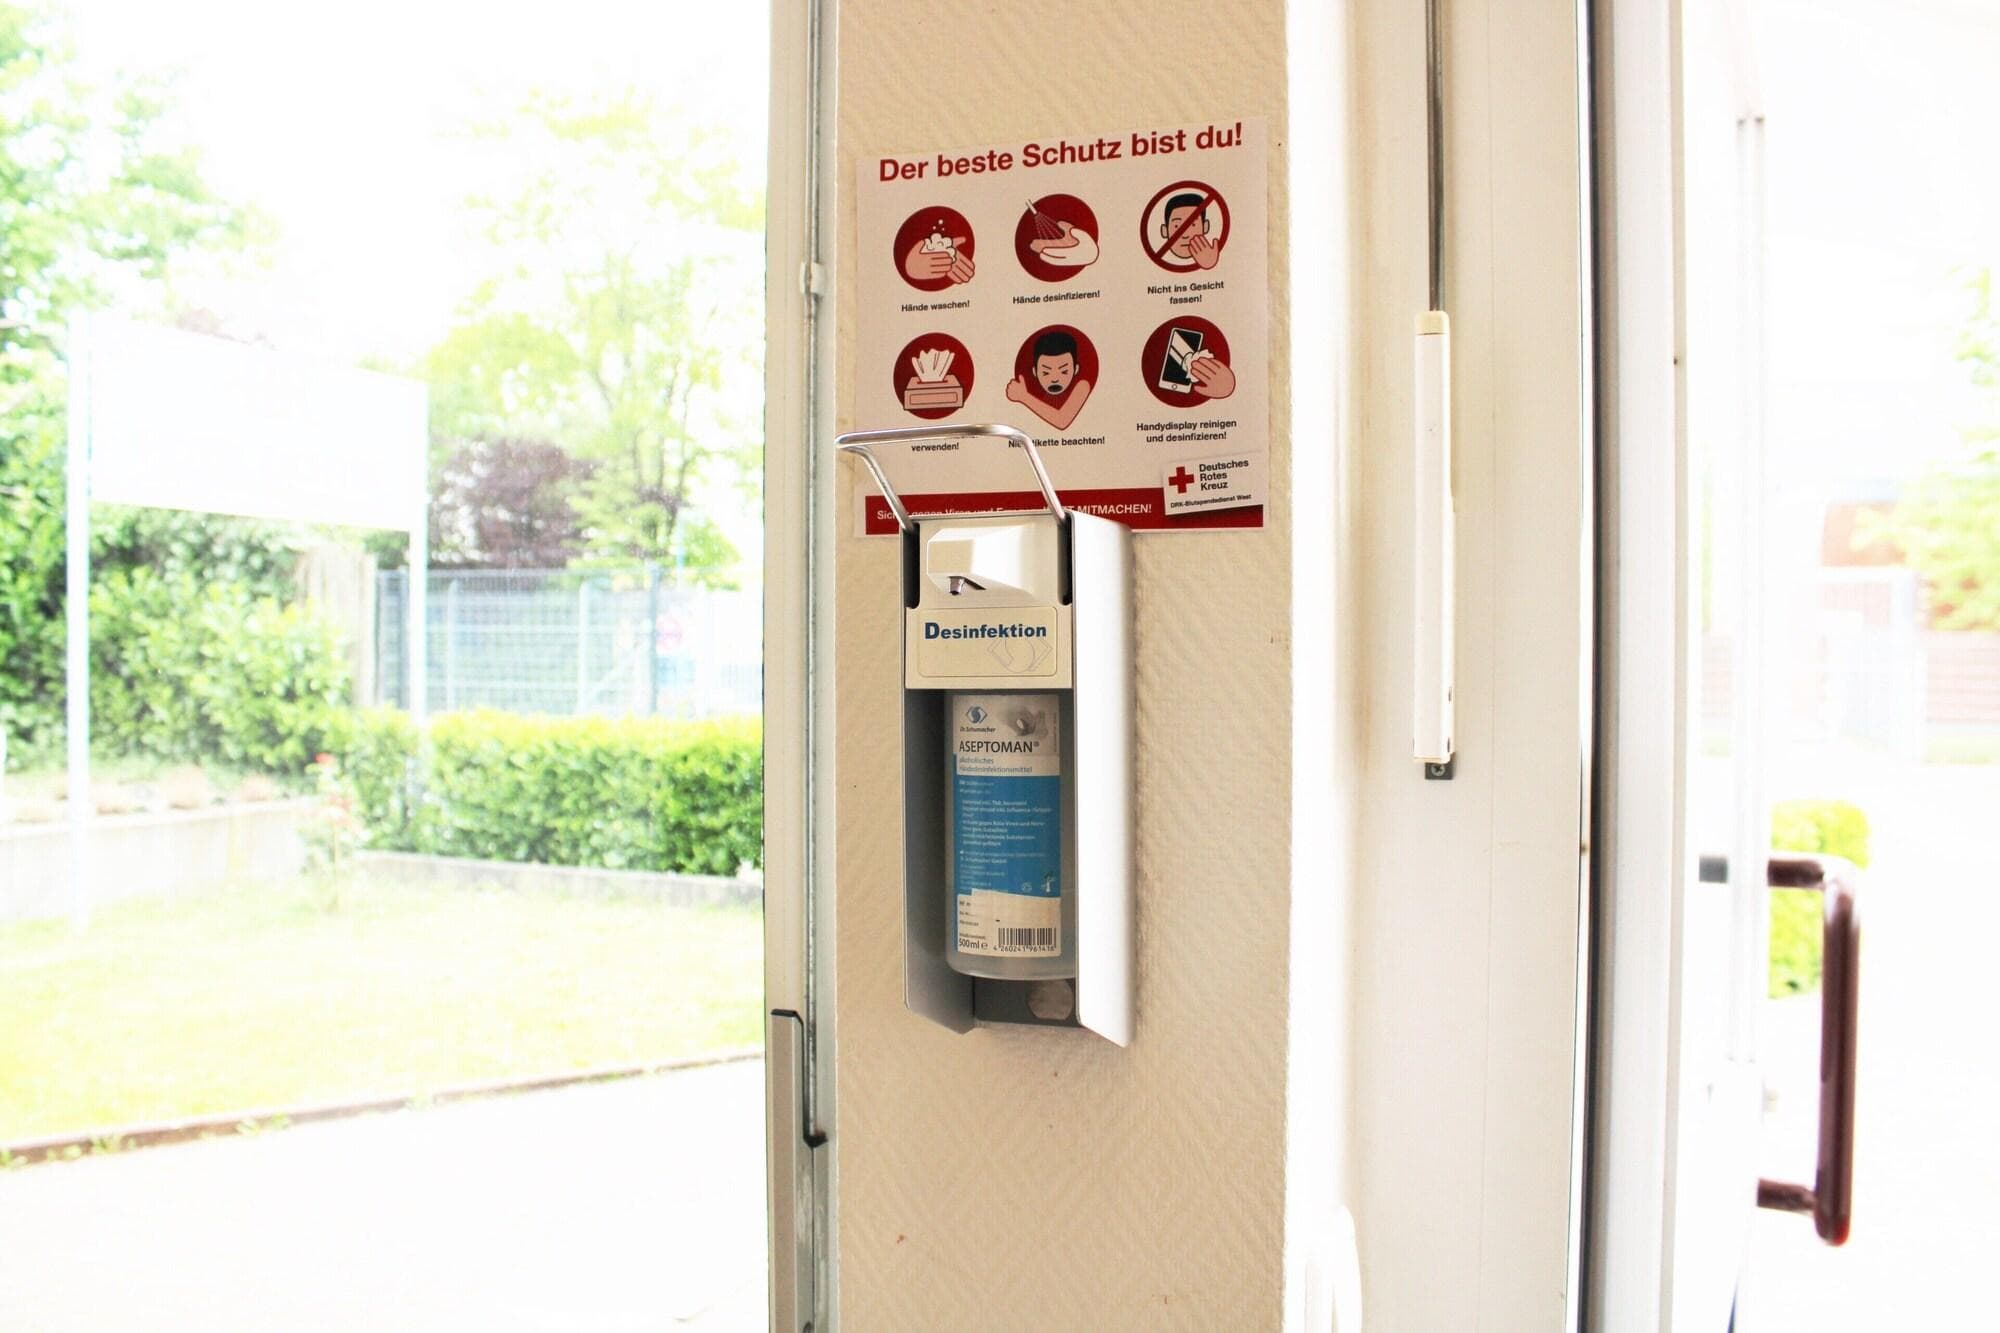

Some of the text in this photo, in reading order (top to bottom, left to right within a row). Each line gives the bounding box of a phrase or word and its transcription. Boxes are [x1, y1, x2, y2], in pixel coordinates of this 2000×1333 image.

[880, 122, 1242, 182] Der beste Schutz bist du!
[1147, 281, 1224, 294] Nicht ins Gesicht
[1012, 290, 1100, 304] Hände desinfizieren!
[1169, 295, 1202, 304] fassen!
[901, 300, 970, 312] Hände waschen!
[1136, 419, 1237, 431] Handydisplay reinigen
[1062, 436, 1105, 446] beachten!
[1146, 431, 1227, 443] und desinfizieren!
[911, 442, 960, 451] verwenden!
[1199, 460, 1249, 472] Deutsches
[1200, 472, 1227, 481] Rotes
[1200, 482, 1228, 491] Kreuz
[1077, 503, 1152, 515] MITMACHEN!
[924, 622, 1047, 640] Desinfektion
